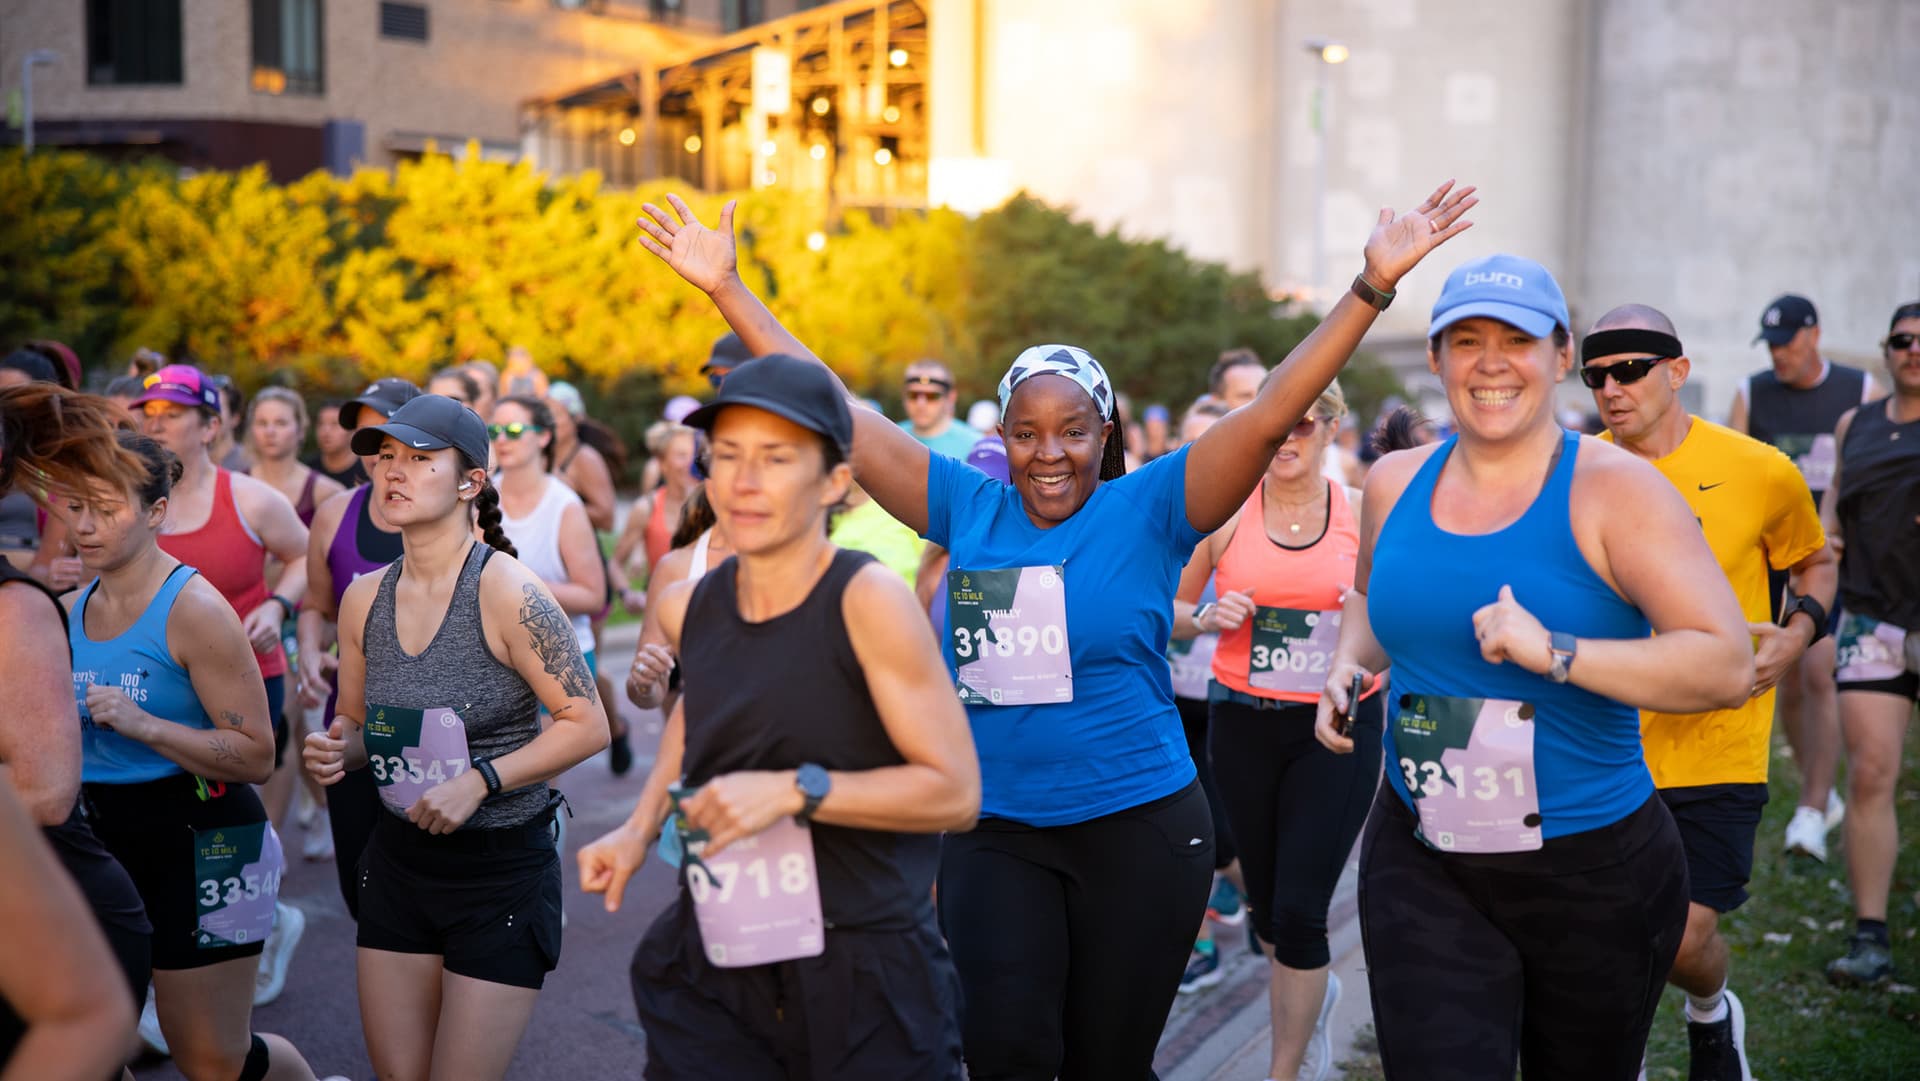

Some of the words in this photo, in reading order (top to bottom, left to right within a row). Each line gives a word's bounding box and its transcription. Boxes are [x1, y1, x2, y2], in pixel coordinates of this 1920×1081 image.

[1464, 271, 1523, 290] burn
[953, 592, 961, 600] TC
[969, 592, 984, 601] MILE
[954, 624, 1064, 658] 31890
[120, 673, 140, 687] 100
[1400, 717, 1410, 726] TC
[370, 754, 465, 784] 33547
[1400, 757, 1525, 801] 33131
[201, 848, 210, 856] TC
